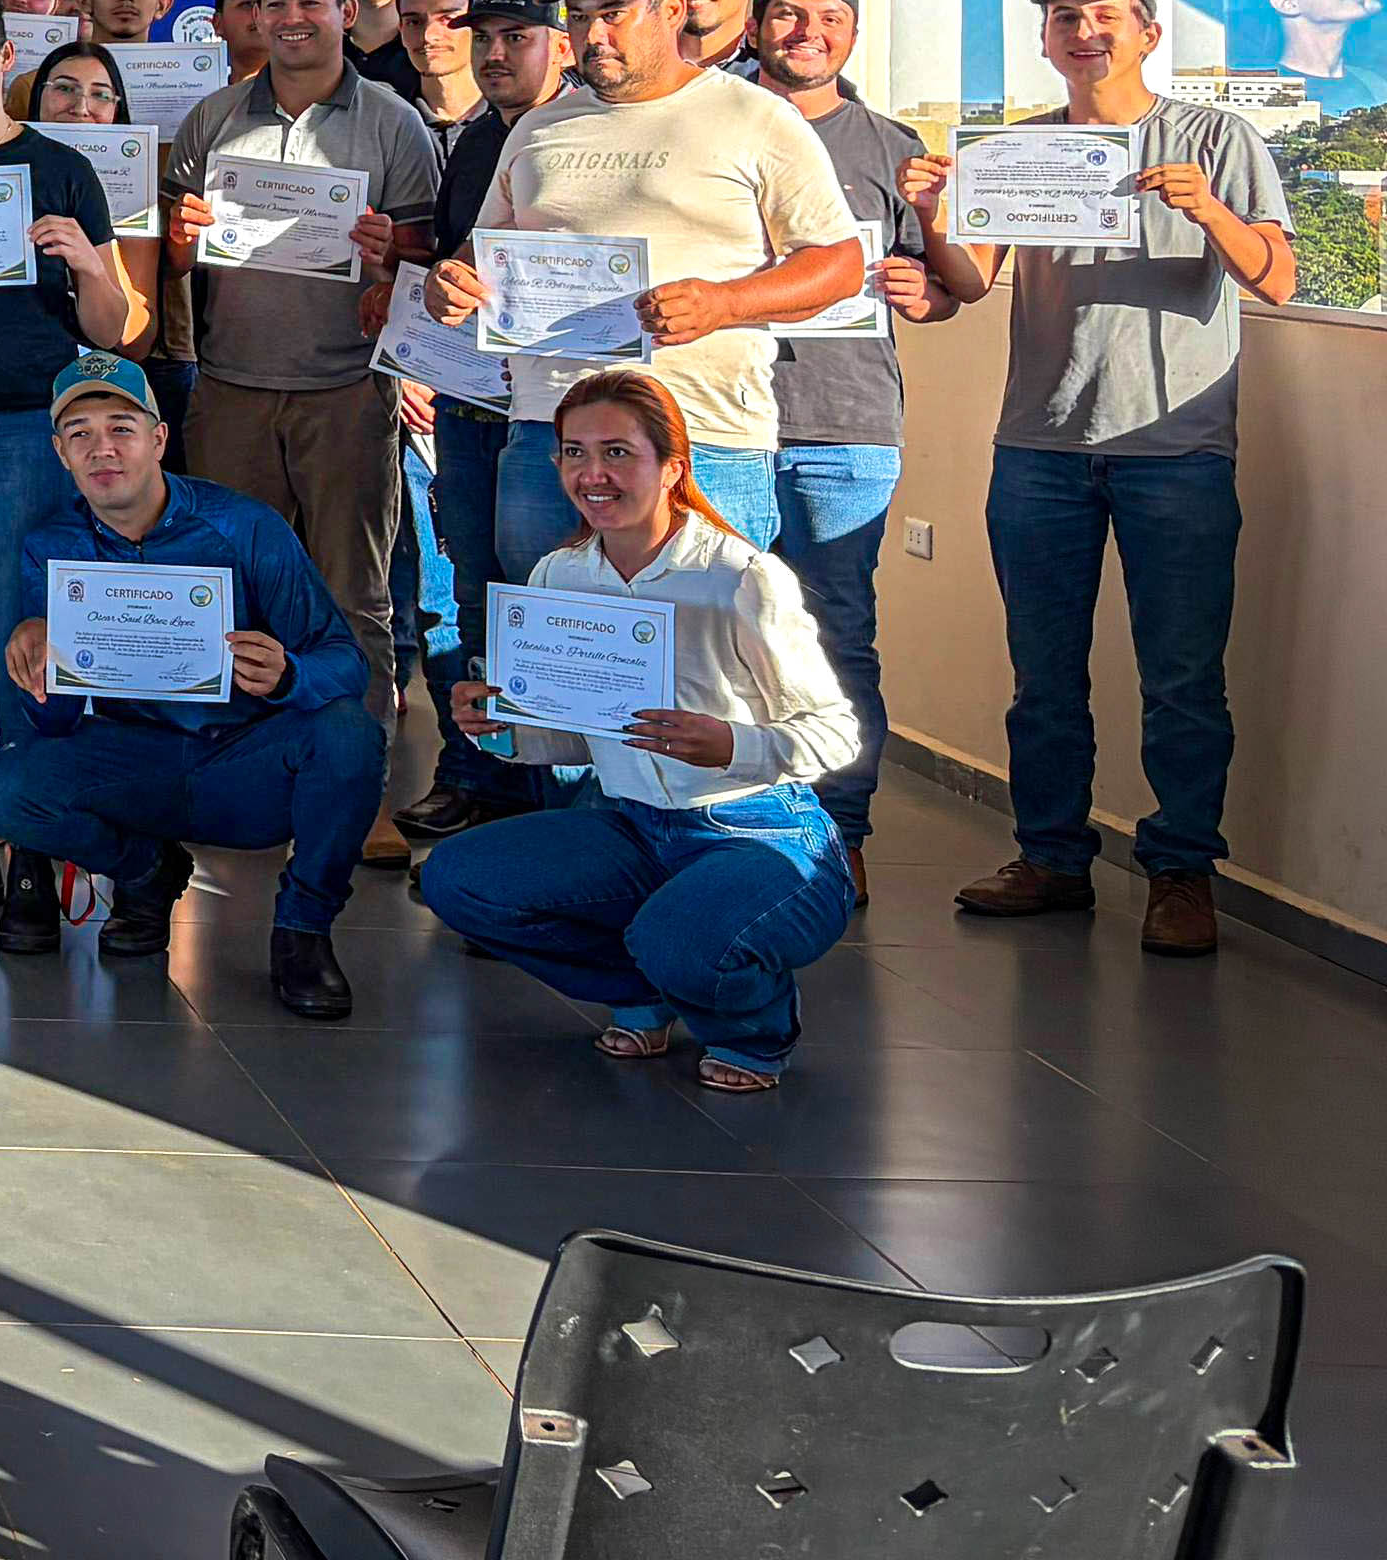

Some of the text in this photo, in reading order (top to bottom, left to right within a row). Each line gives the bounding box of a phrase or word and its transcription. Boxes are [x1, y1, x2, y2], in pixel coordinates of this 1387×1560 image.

[547, 151, 670, 170] ORIGINALS
[255, 179, 316, 195] CERTIFICADO
[1006, 212, 1078, 223] CERTIFICADO
[529, 254, 594, 268] CERTIFICADO
[105, 588, 173, 601] CERTIFICADO
[546, 616, 616, 634] CERTIFICADO
